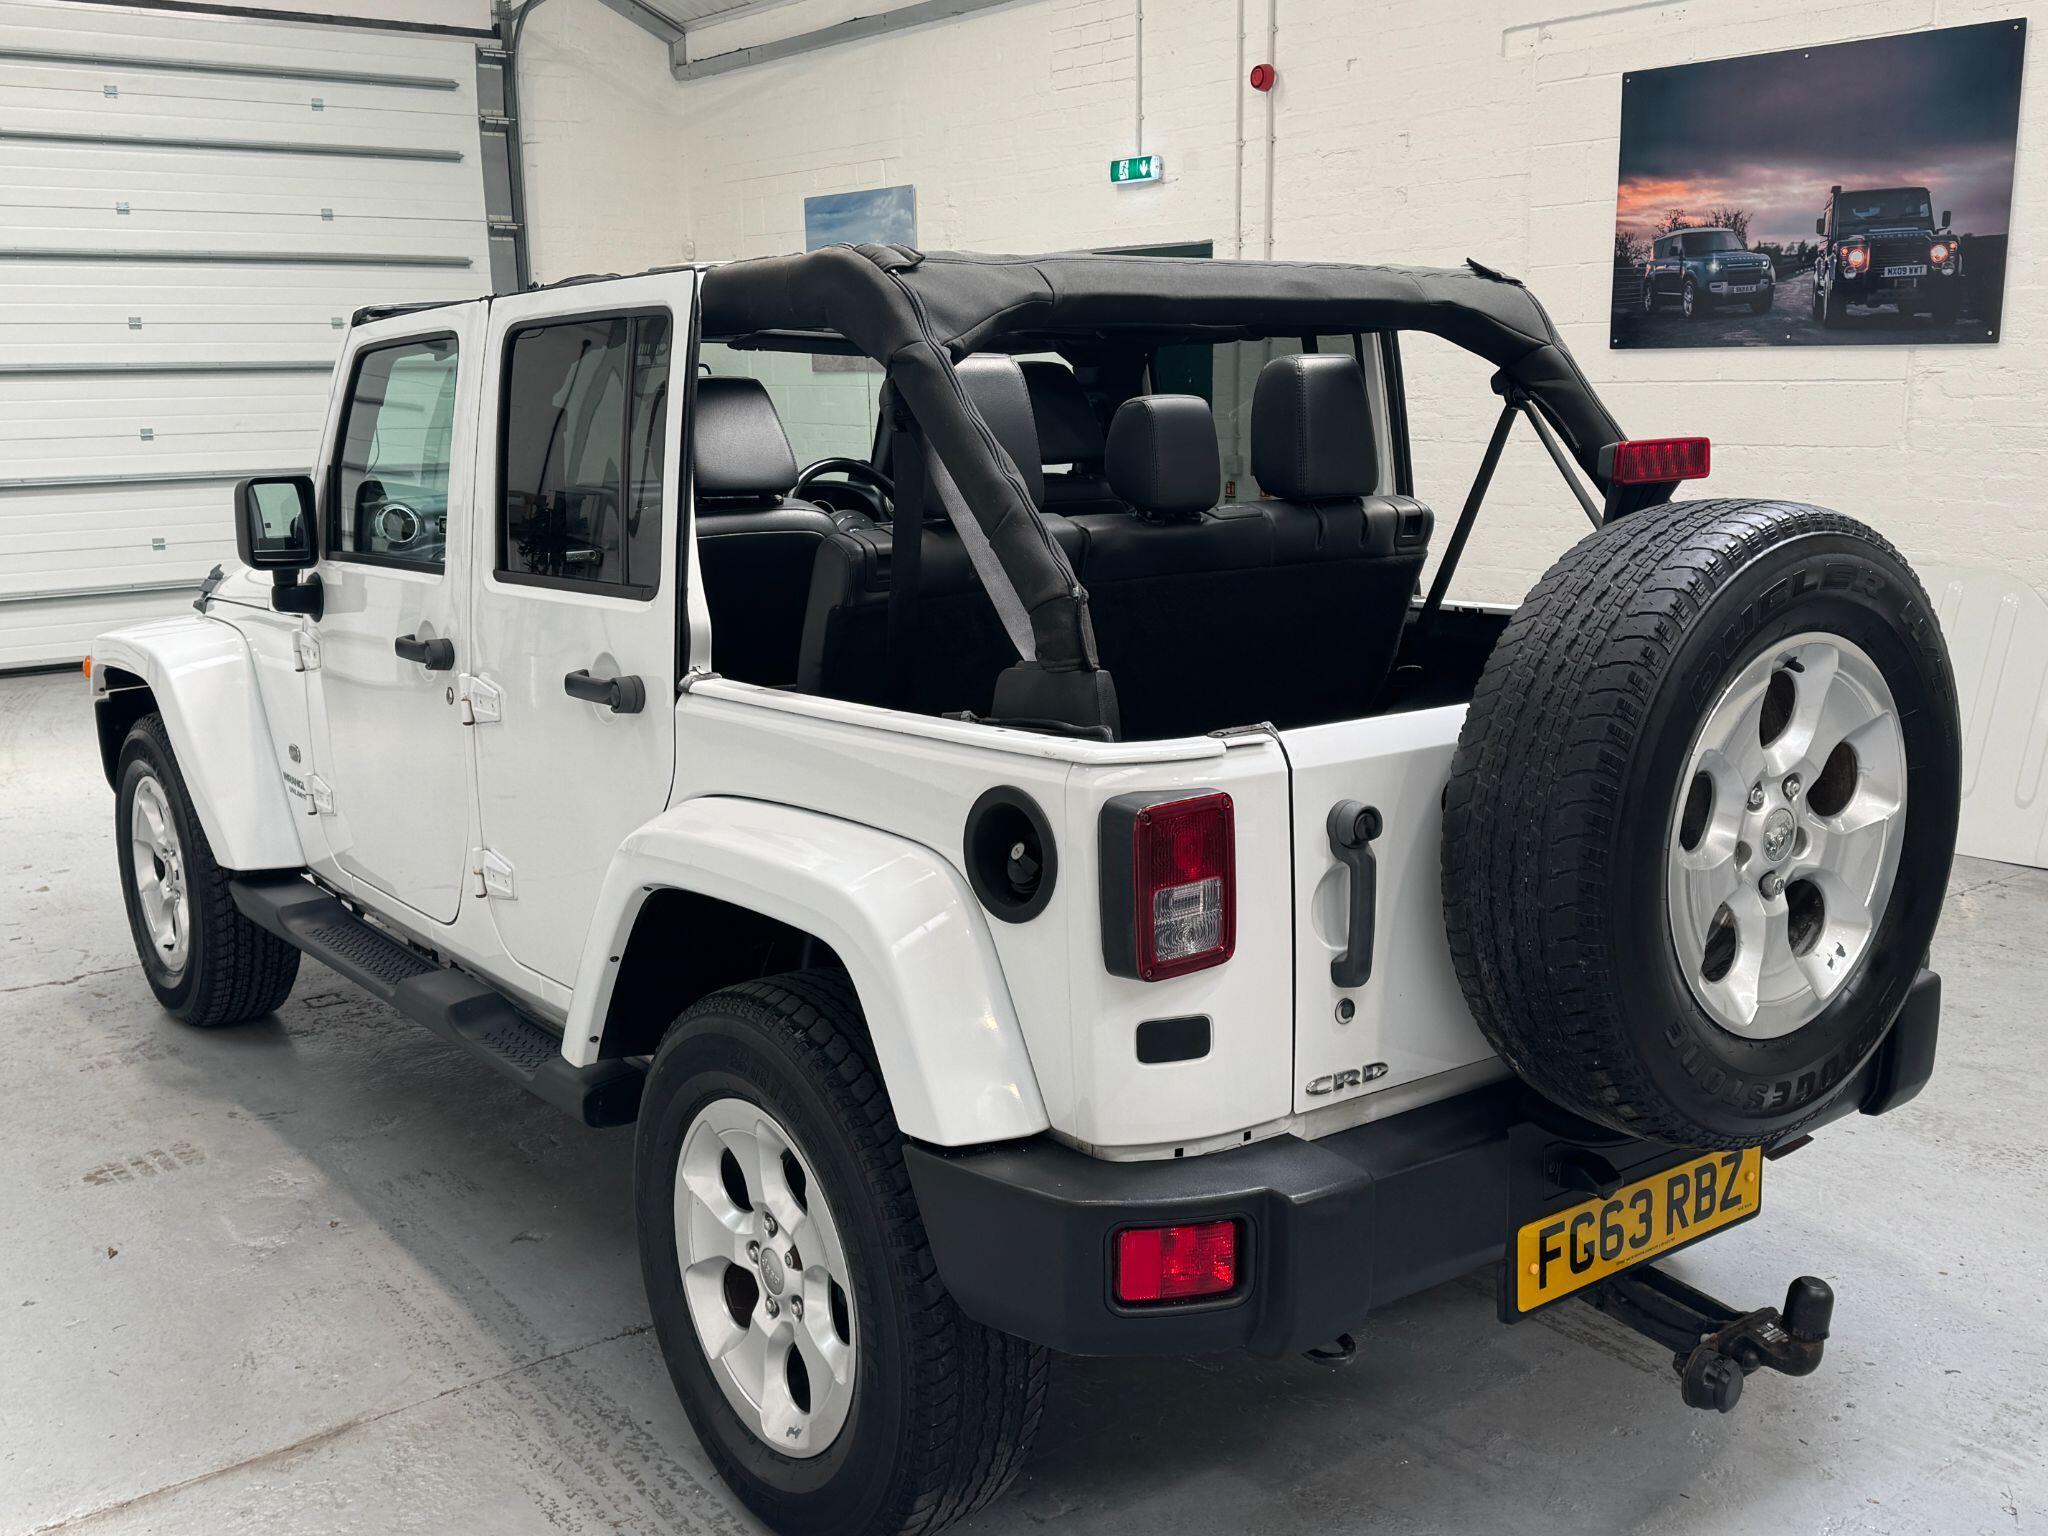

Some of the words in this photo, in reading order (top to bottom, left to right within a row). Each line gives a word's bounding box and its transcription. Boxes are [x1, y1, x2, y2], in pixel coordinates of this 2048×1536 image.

[1305, 1062, 1389, 1095] CRD
[1538, 1188, 1654, 1290] FG63
[1666, 1150, 1744, 1236] RBZ
